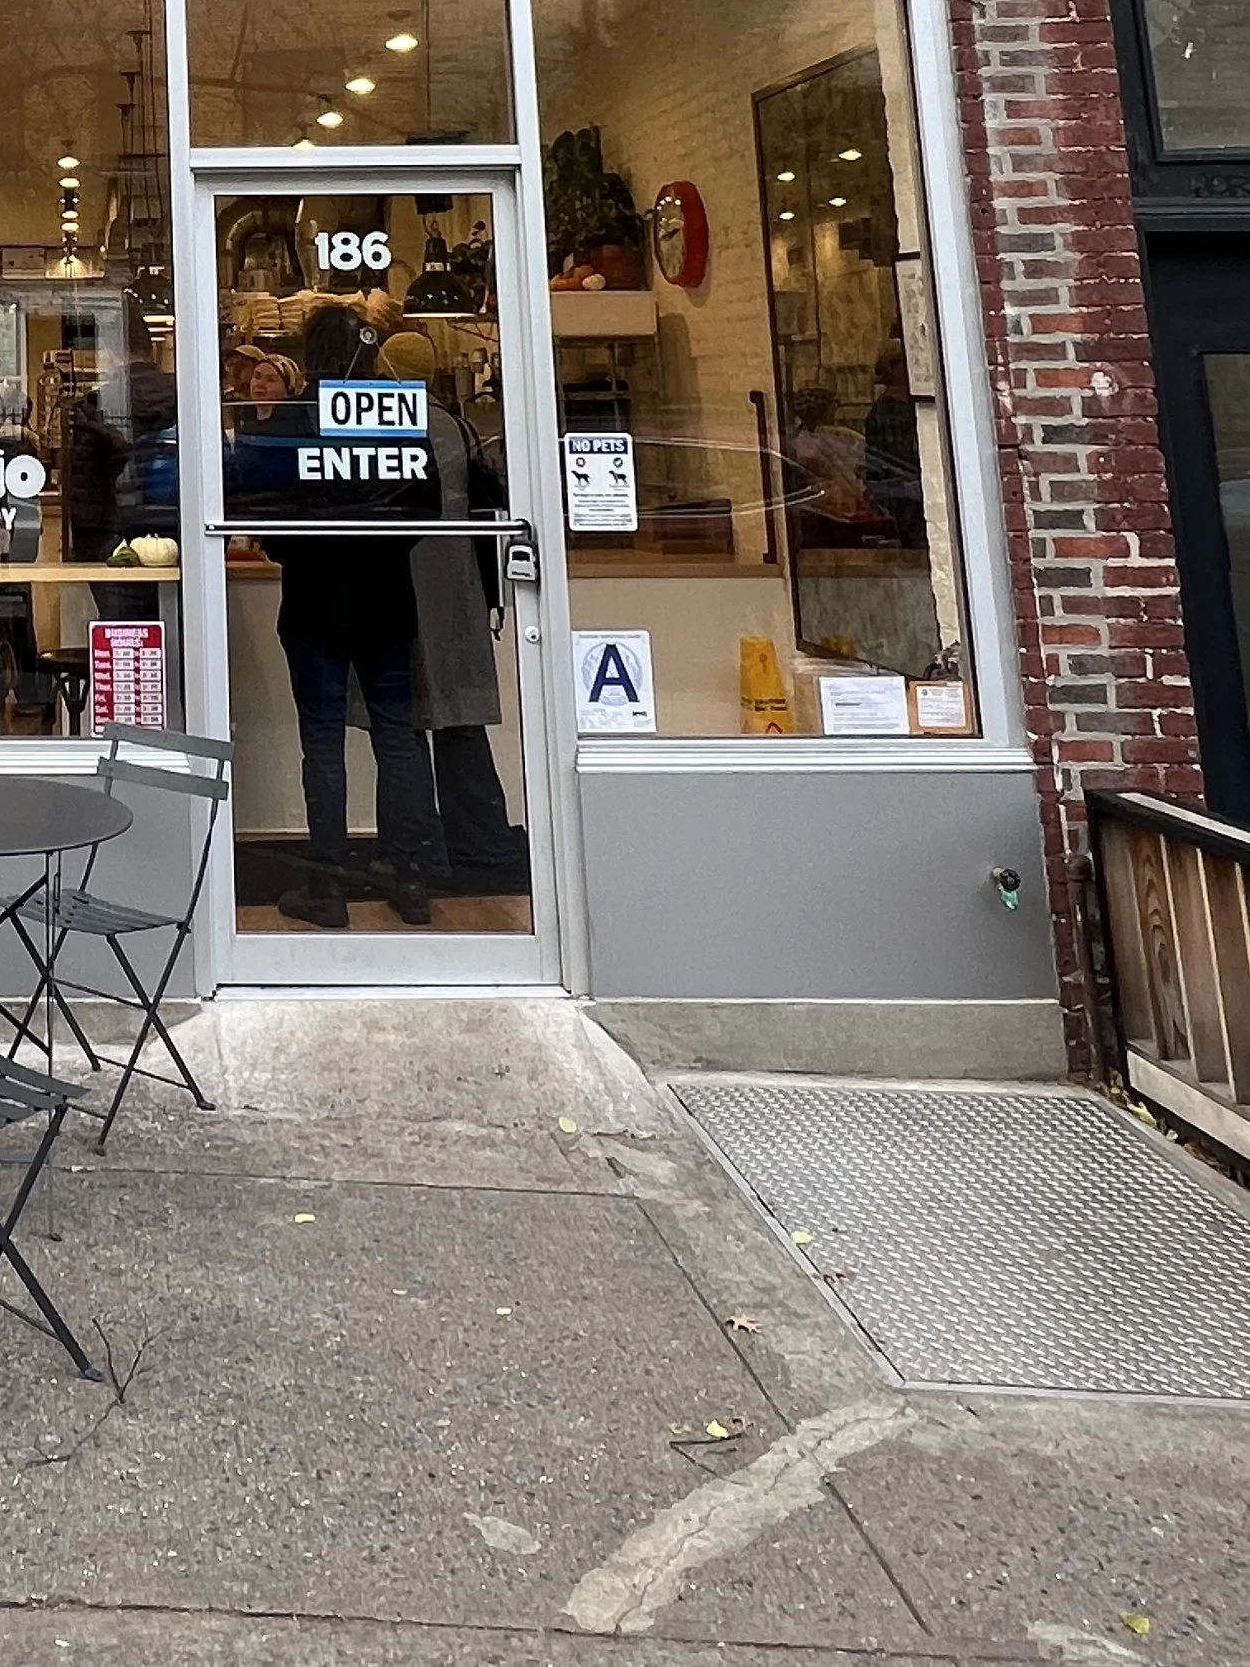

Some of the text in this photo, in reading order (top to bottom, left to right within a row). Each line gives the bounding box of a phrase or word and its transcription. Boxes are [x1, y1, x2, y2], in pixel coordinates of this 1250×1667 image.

[314, 230, 392, 271] 186
[331, 391, 418, 426] OPEN
[572, 438, 625, 452] NO PETS
[298, 447, 428, 480] ENTER
[588, 644, 640, 702] A
